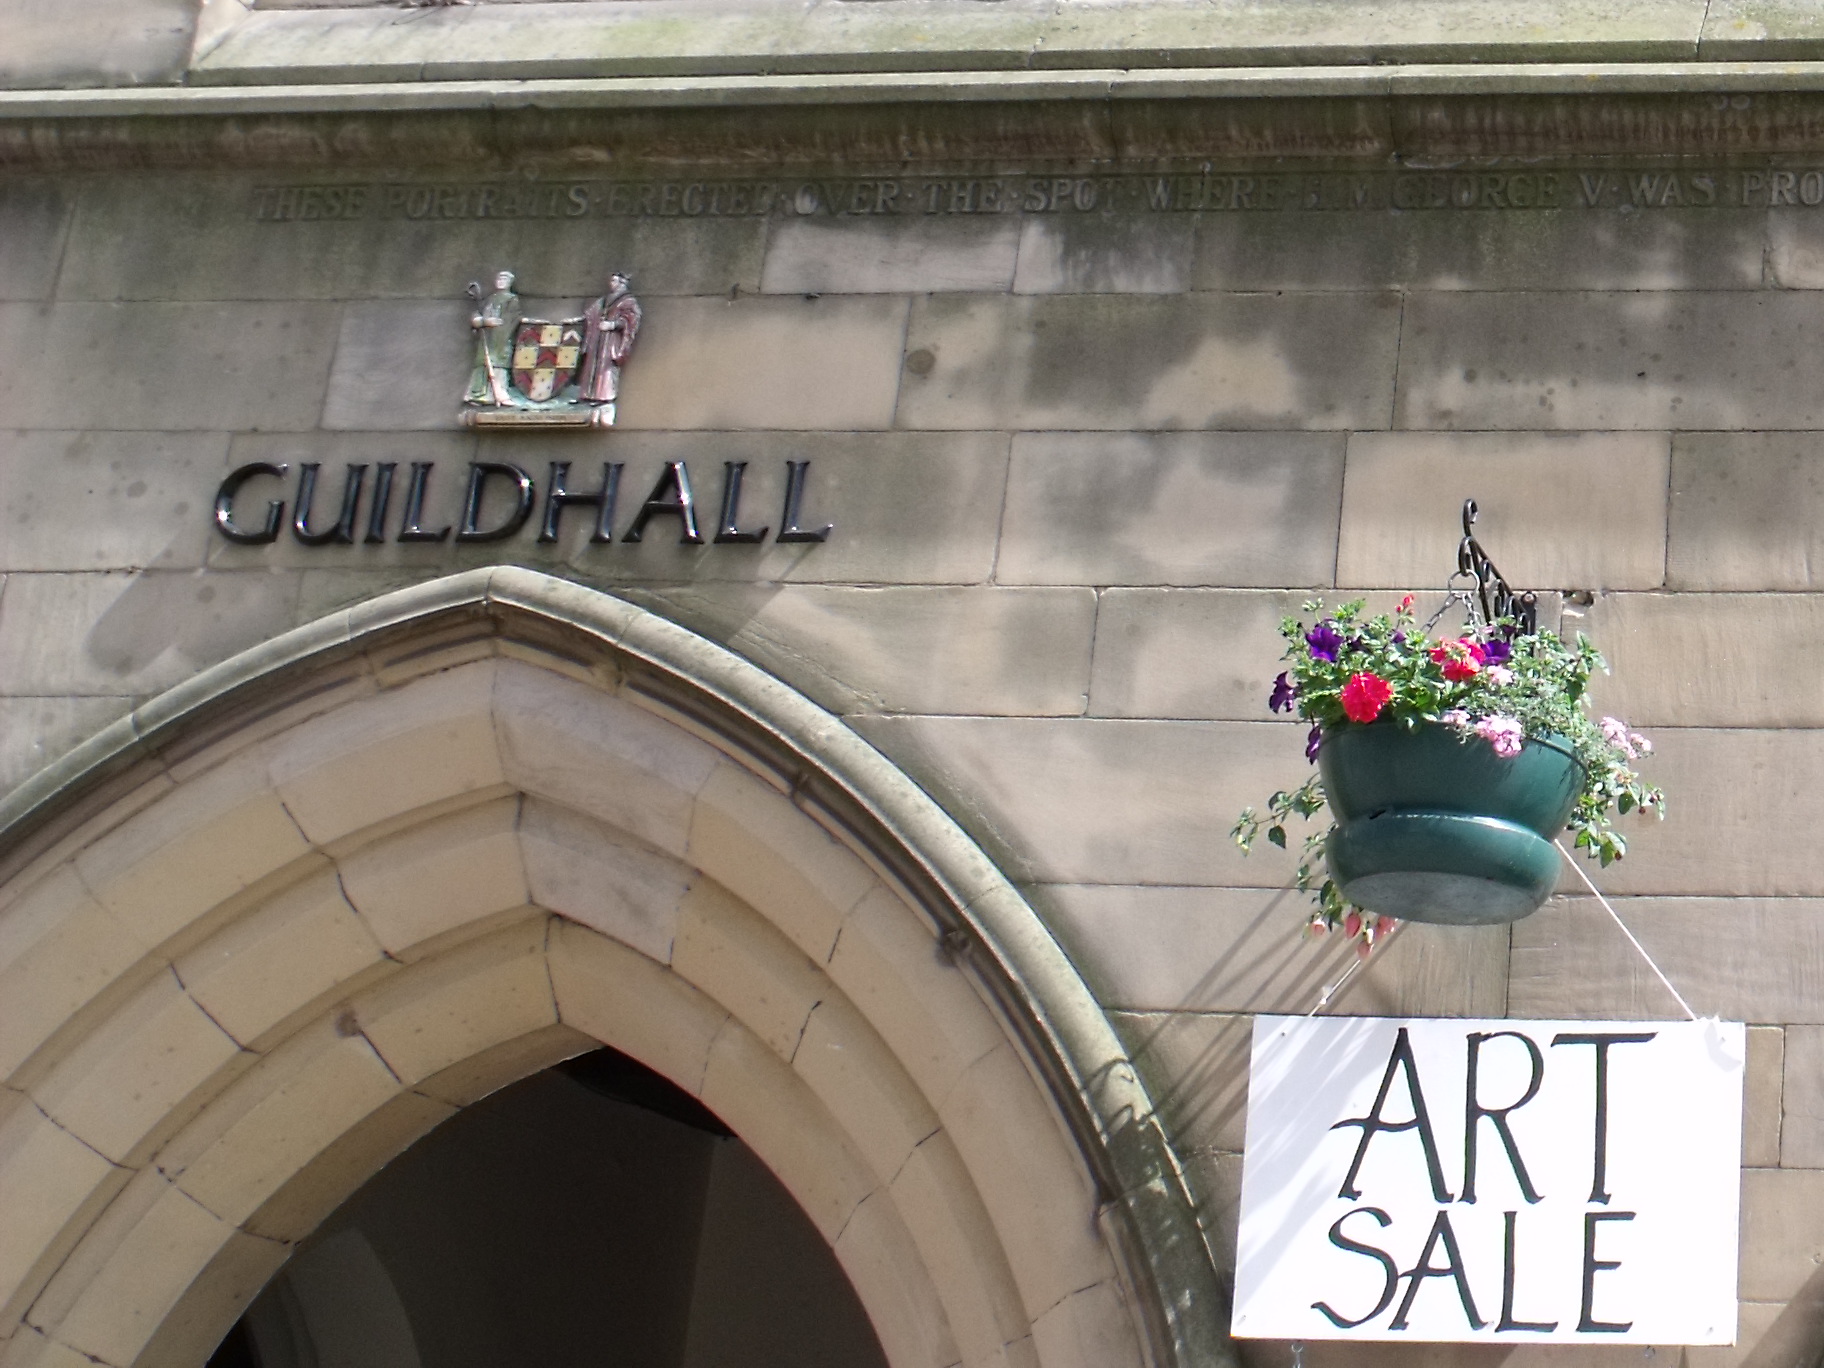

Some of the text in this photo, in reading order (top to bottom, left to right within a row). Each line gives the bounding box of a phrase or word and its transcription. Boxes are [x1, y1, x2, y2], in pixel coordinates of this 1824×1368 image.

[924, 178, 1003, 213] THE
[215, 461, 834, 546] GUILDHALL
[1329, 1027, 1658, 1205] ART
[1311, 1207, 1637, 1333] SALE
